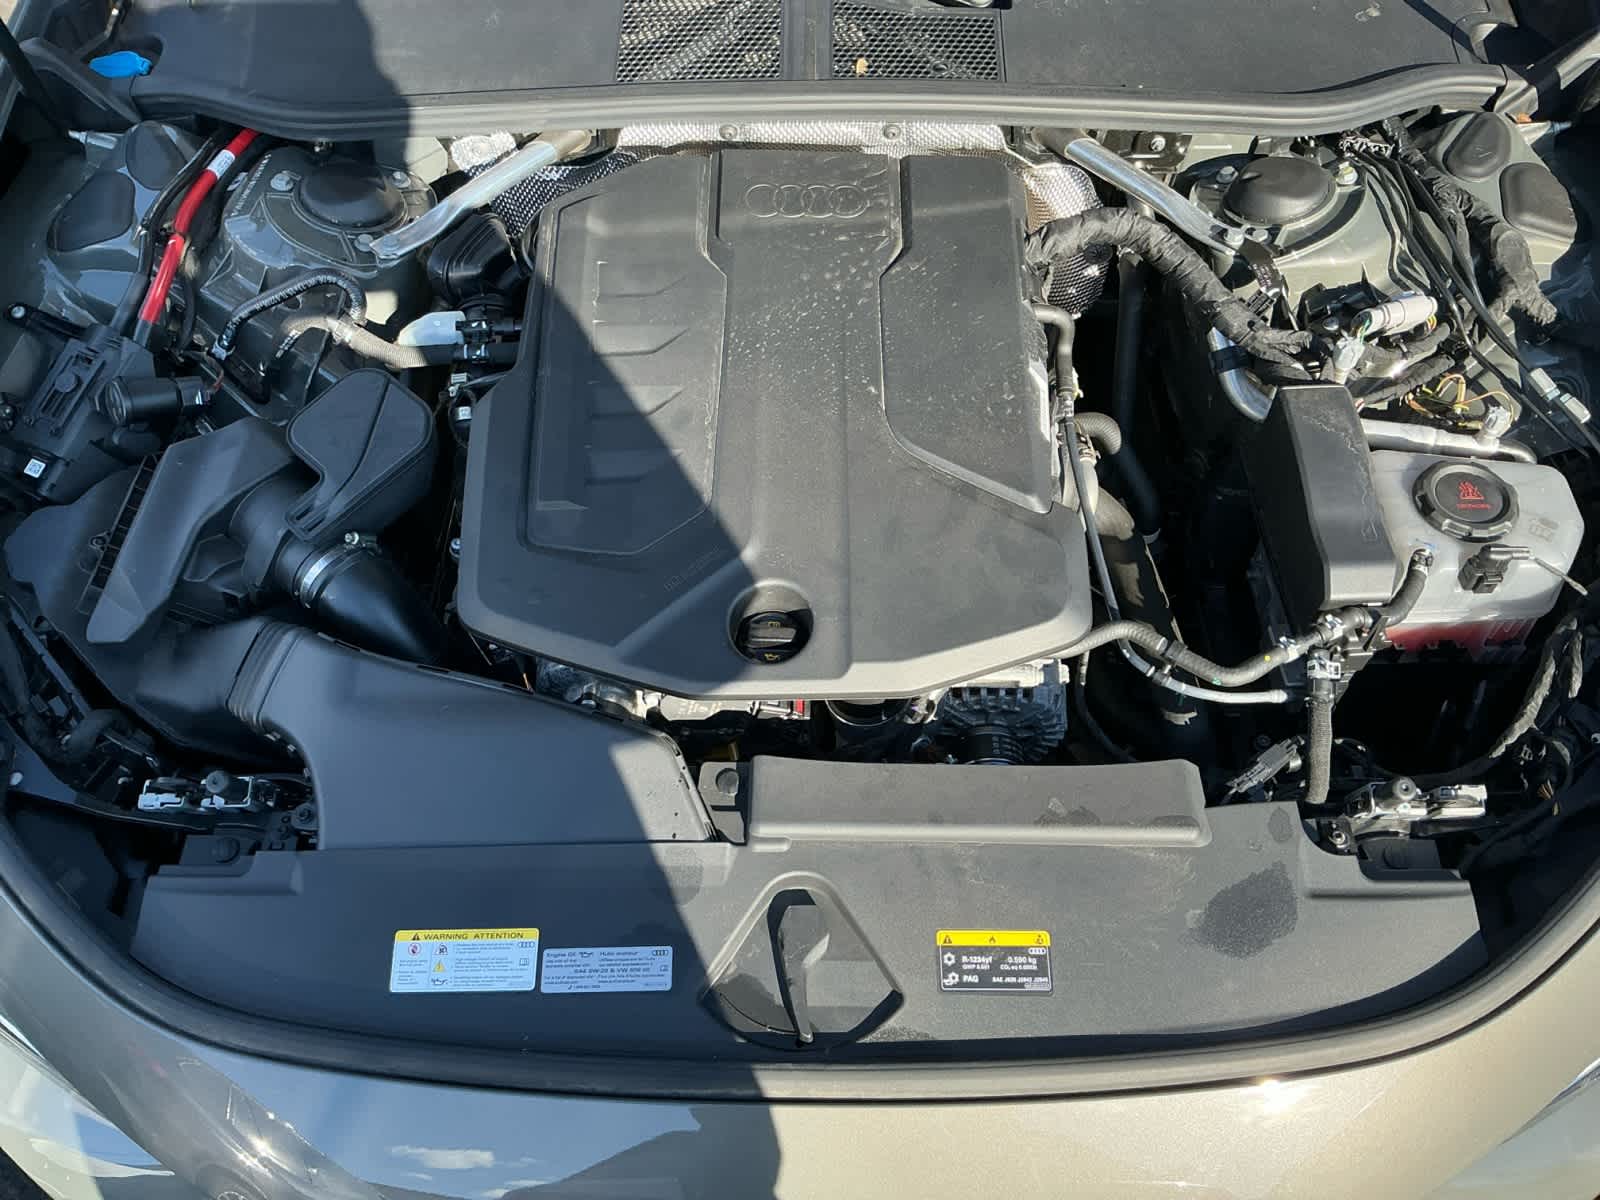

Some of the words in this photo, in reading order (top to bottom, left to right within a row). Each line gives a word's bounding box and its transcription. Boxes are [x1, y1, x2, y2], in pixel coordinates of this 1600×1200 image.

[424, 933, 468, 941] WARNING
[473, 932, 524, 940] ATTENTION
[1028, 956, 1037, 965] kg
[962, 975, 979, 983] PAG
